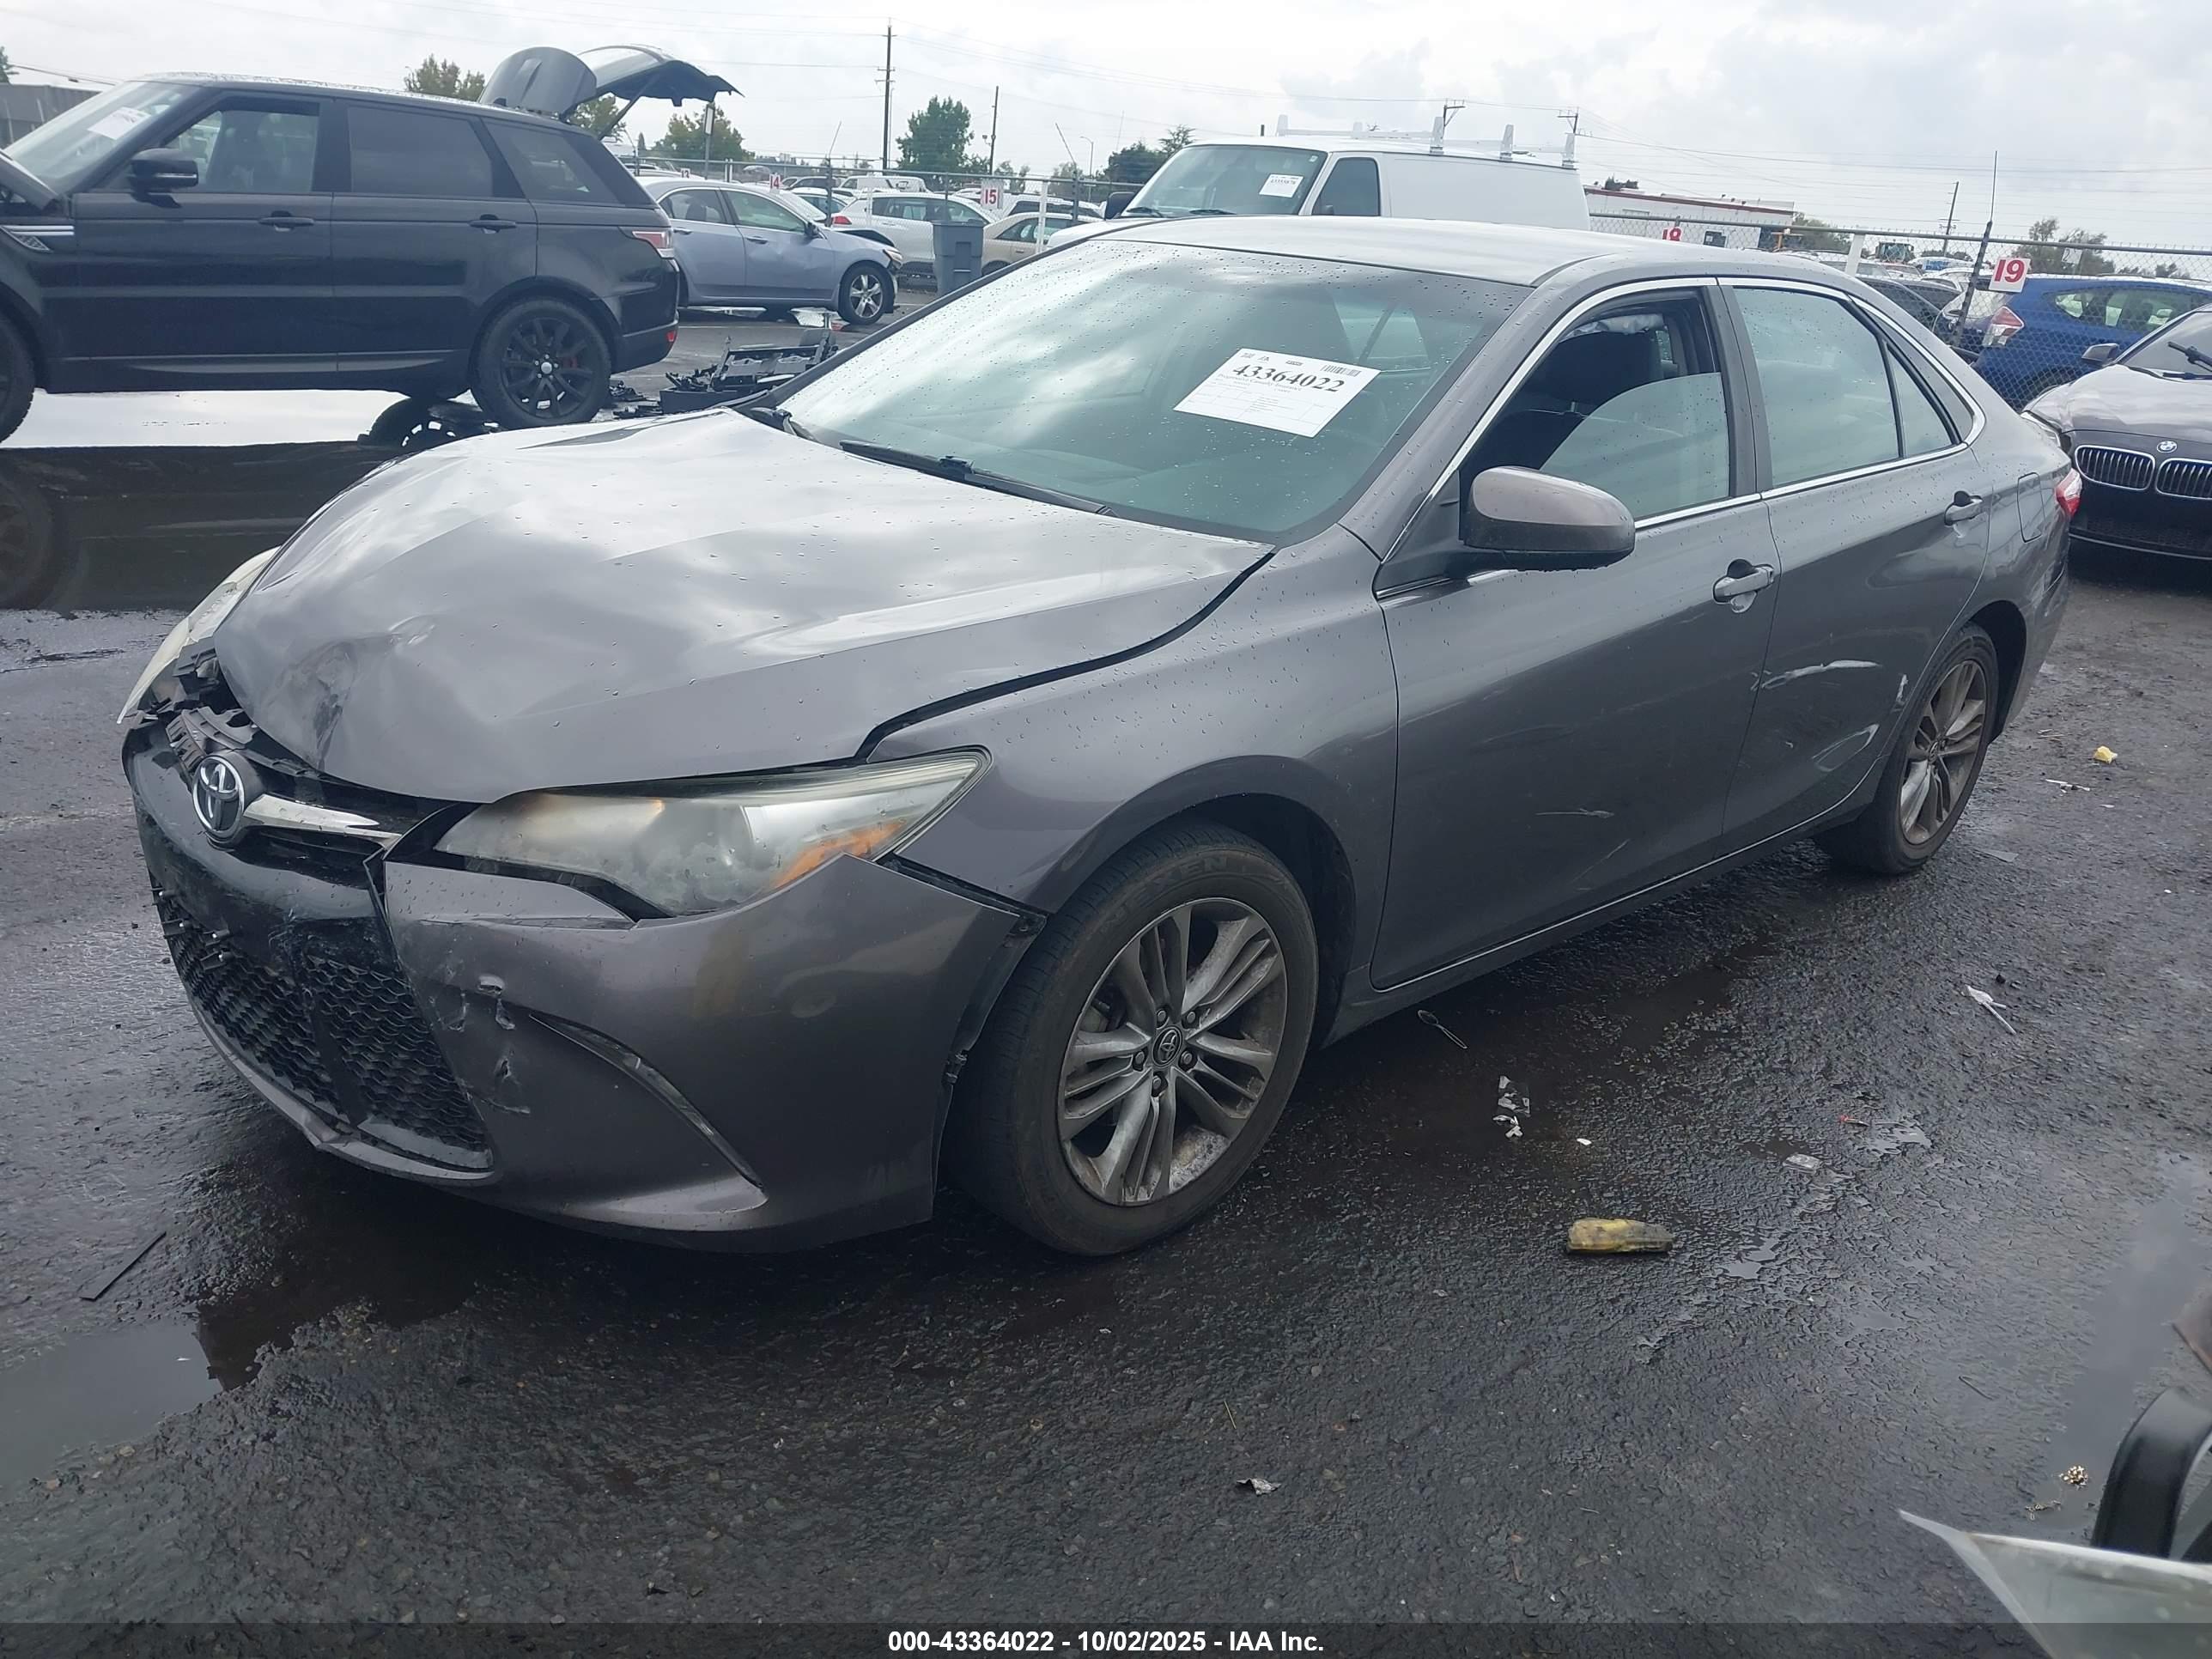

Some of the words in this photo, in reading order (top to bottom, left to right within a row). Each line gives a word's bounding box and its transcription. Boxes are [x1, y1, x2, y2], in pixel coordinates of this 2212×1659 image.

[770, 175, 780, 189] 14
[985, 189, 997, 204] 15
[1994, 259, 2025, 283] 19
[1232, 364, 1346, 393] 43364022
